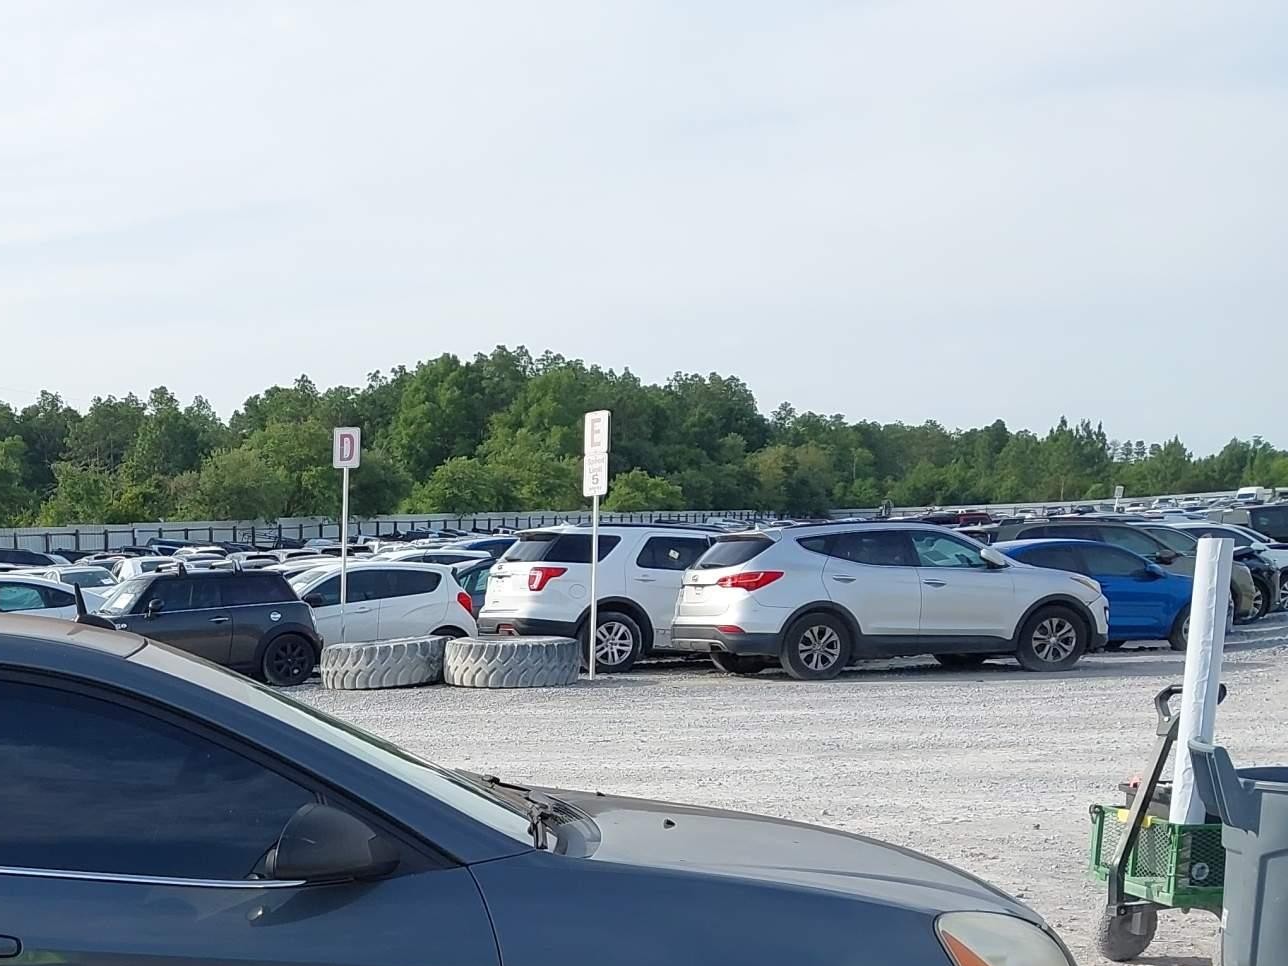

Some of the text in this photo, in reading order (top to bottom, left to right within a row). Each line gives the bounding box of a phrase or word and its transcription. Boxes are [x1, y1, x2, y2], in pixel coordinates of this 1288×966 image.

[591, 418, 601, 448] E
[340, 434, 354, 461] D
[592, 475, 599, 485] 5
